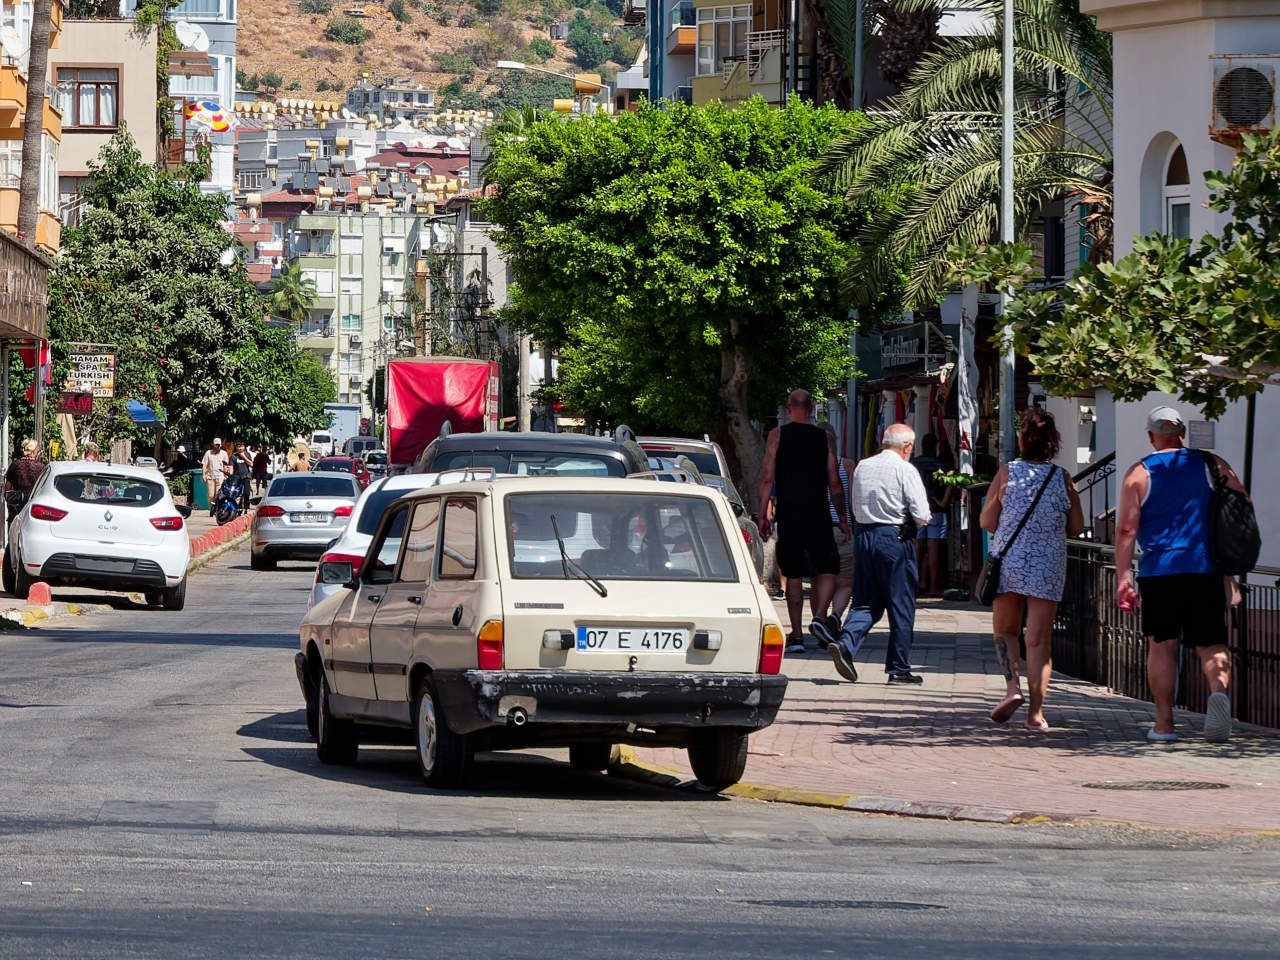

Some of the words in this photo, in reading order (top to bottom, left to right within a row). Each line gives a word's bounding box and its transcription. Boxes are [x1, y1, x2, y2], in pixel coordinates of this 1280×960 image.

[587, 630, 609, 649] 07
[618, 631, 632, 649] E
[640, 631, 684, 650] 4176
